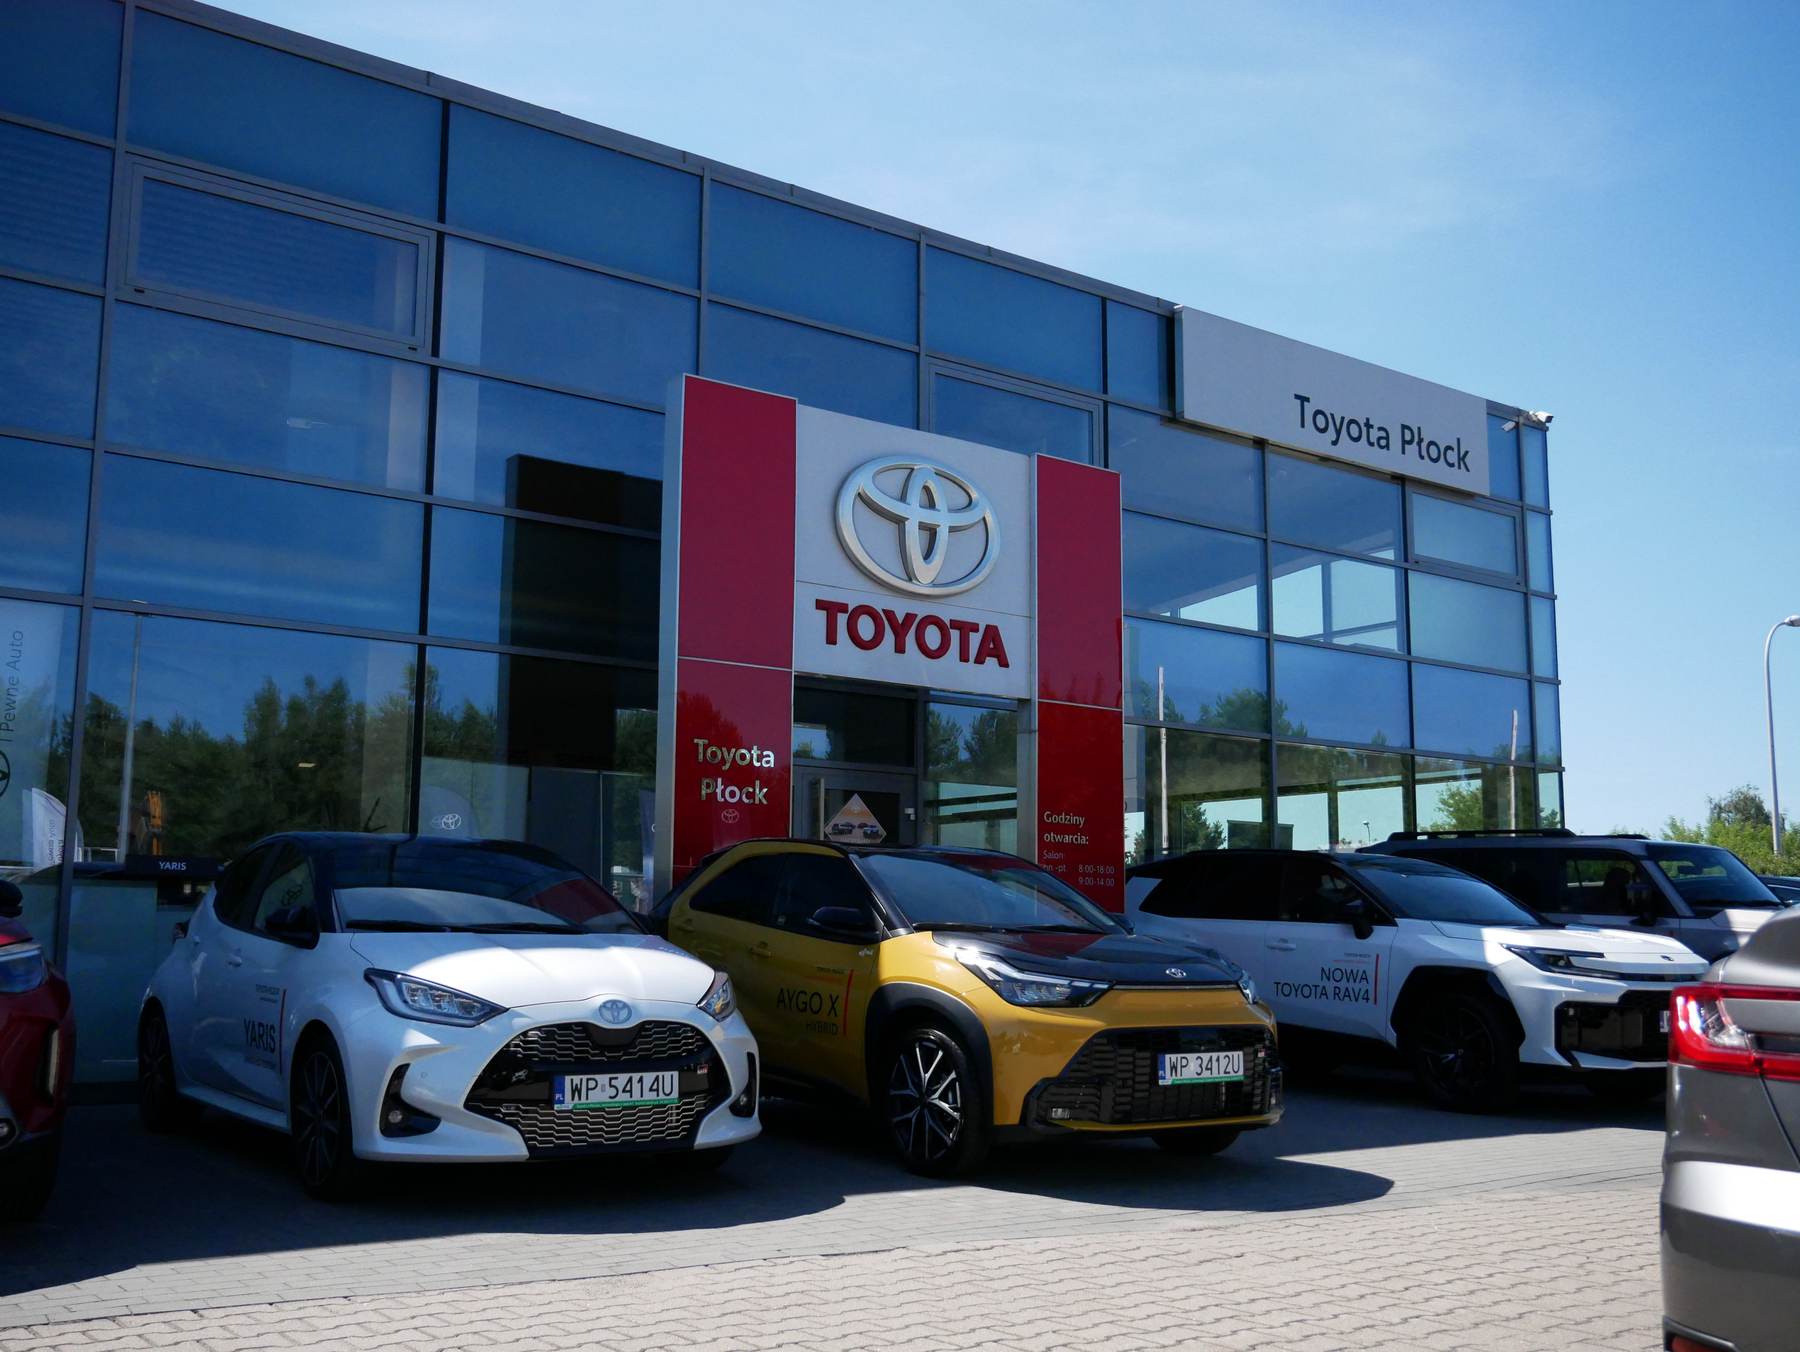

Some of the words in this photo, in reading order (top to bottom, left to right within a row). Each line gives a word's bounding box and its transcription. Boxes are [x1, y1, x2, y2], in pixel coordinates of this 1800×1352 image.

[1294, 394, 1390, 451] Toyota
[1401, 423, 1470, 472] Płock
[815, 599, 1010, 669] TOYOTA
[6, 630, 24, 671] Auto
[0, 674, 19, 732] Pewne
[693, 738, 775, 770] Toyota
[701, 777, 768, 805] Płock
[1043, 811, 1085, 828] Godziny
[1043, 832, 1089, 845] otwarcia:
[159, 861, 187, 871] YARIS
[1043, 849, 1064, 860] Salon
[1320, 967, 1369, 984] NOWA
[776, 987, 823, 1015] AYGO
[827, 992, 840, 1017] X
[1273, 981, 1329, 1000] TOYOTA
[1333, 986, 1370, 1003] RAV4
[243, 1017, 276, 1054] YARIS
[1169, 1055, 1189, 1077] WP
[1195, 1053, 1240, 1076] 3412U
[570, 1077, 599, 1102] WP
[608, 1073, 675, 1100] 5414U
